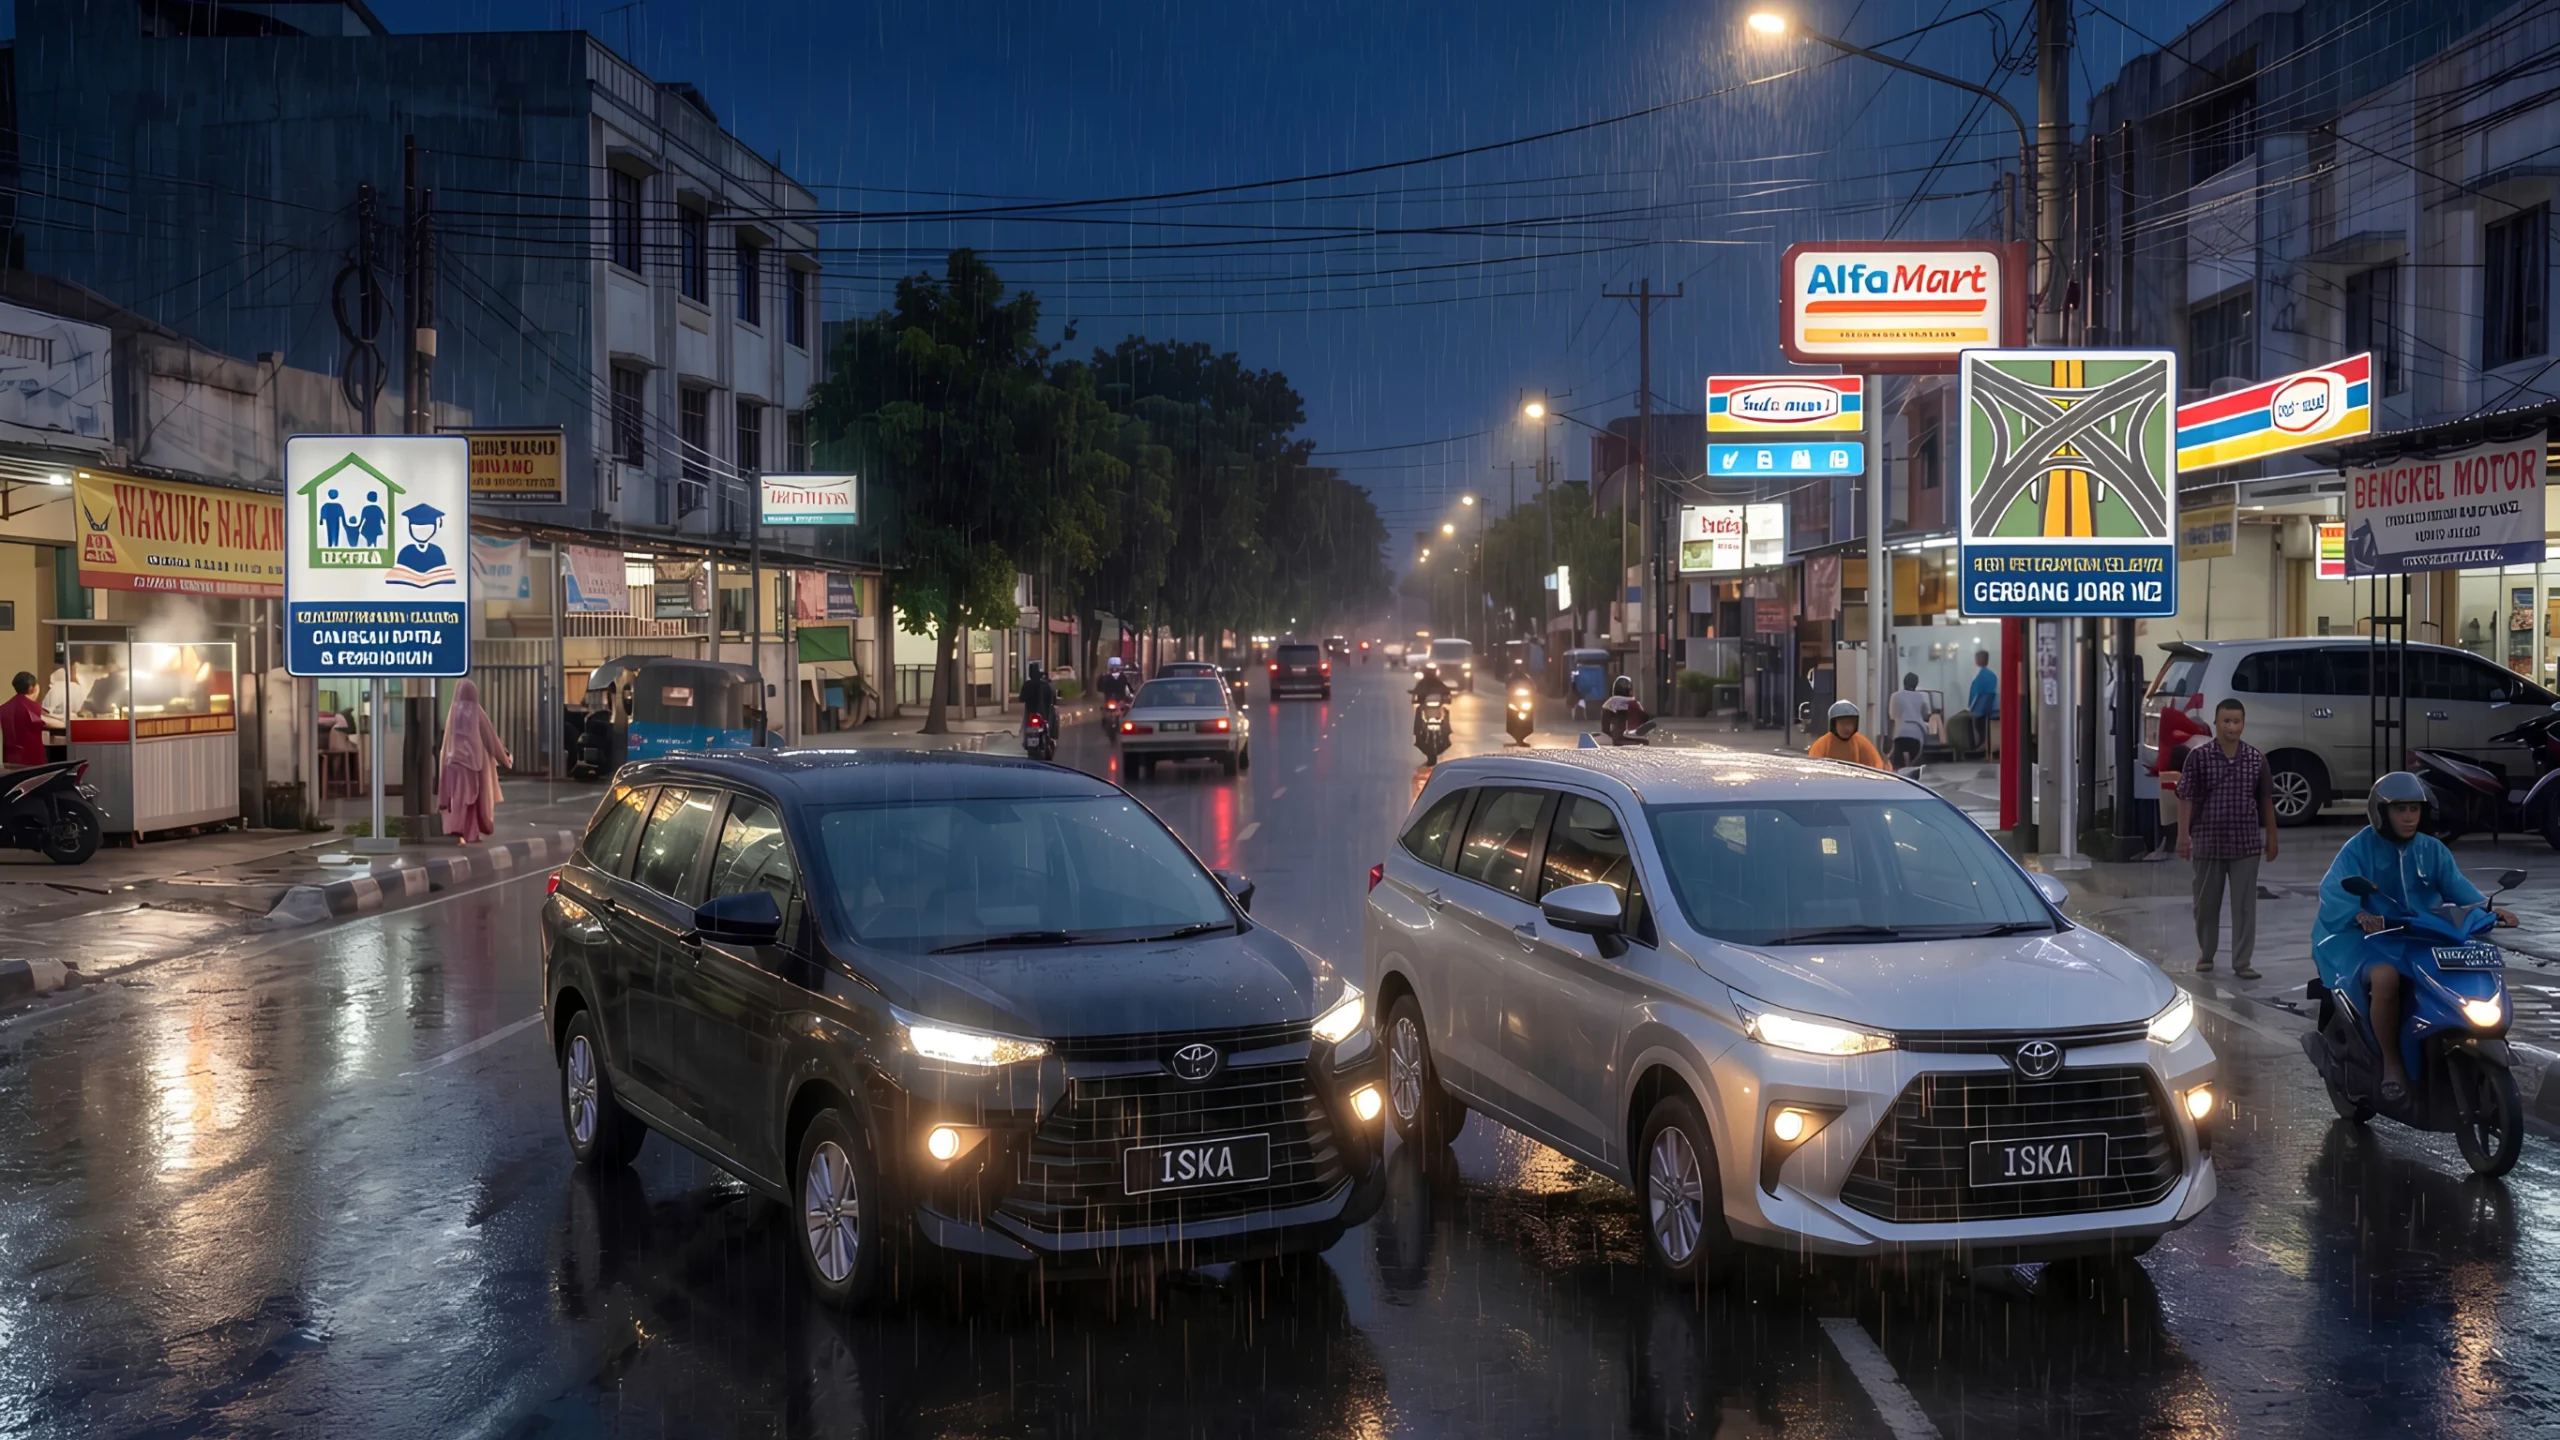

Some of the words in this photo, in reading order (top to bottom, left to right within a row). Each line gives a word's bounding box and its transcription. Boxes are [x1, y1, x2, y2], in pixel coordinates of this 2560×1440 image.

[2355, 464, 2445, 509] BENGKEL
[2453, 449, 2536, 497] MOTOR
[113, 484, 210, 545] WARUNG
[1160, 1146, 1234, 1182] ISKA
[2004, 1144, 2073, 1176] ISKA
